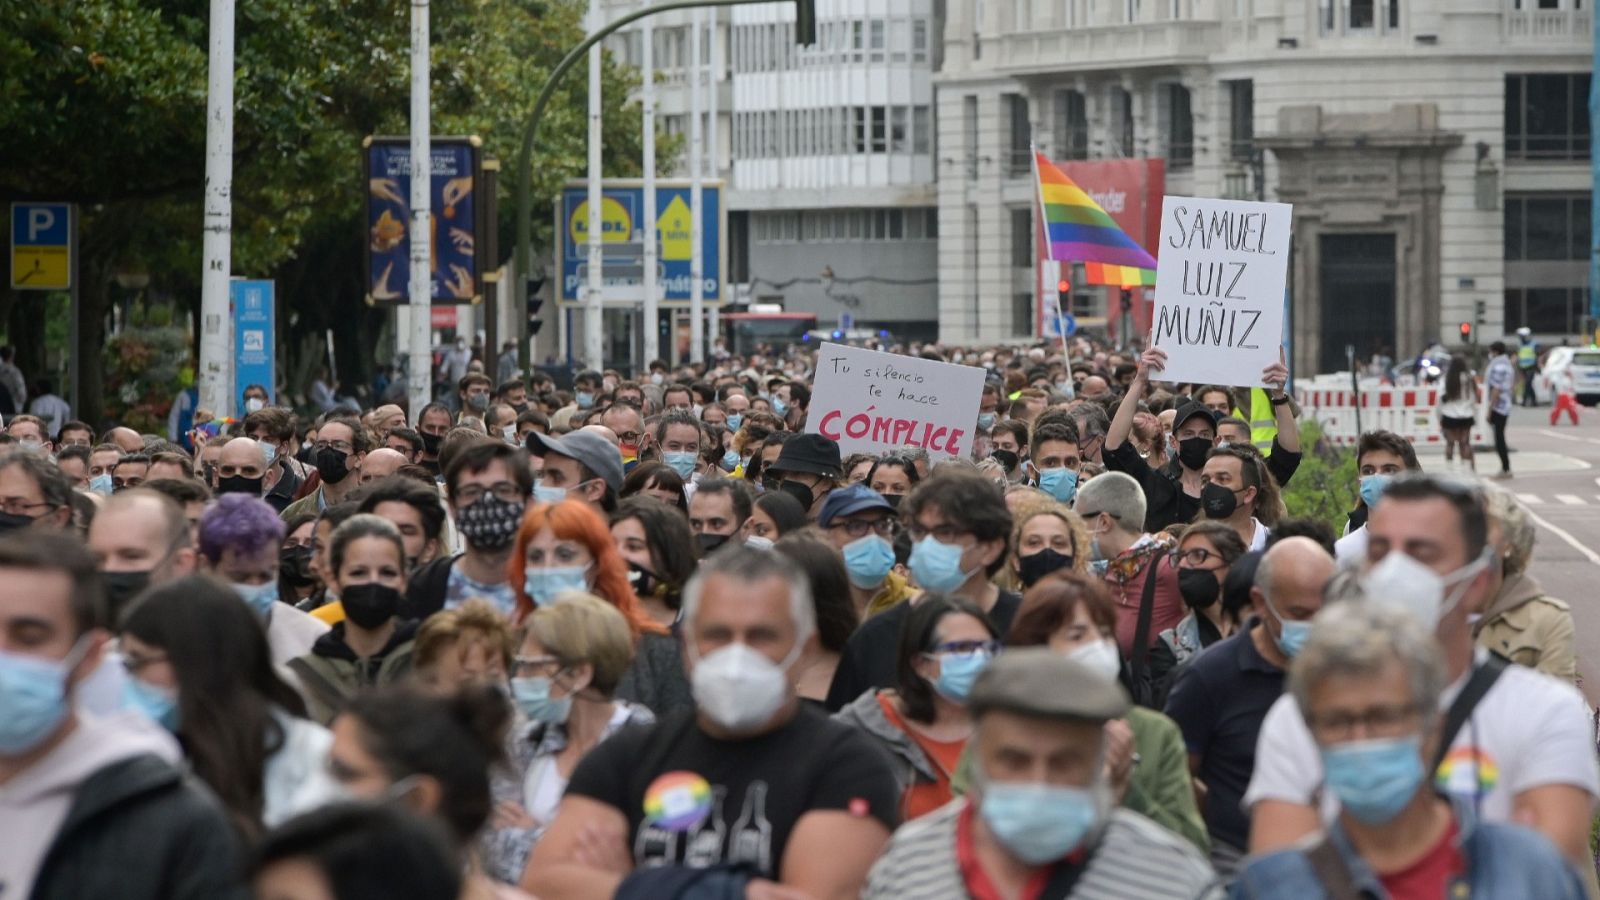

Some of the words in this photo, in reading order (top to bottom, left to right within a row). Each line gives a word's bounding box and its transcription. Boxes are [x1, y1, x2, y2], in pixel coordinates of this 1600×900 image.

[28, 207, 55, 241] P
[575, 220, 627, 232] LDL
[1169, 206, 1276, 255] SAMUEL
[1182, 260, 1247, 300] LUIZ
[1155, 301, 1262, 349] MUÑIZ
[830, 357, 850, 374] Tu
[864, 364, 924, 383] silencio
[869, 384, 882, 397] te
[898, 387, 939, 405] hace
[818, 405, 965, 456] CÓMPLICE
